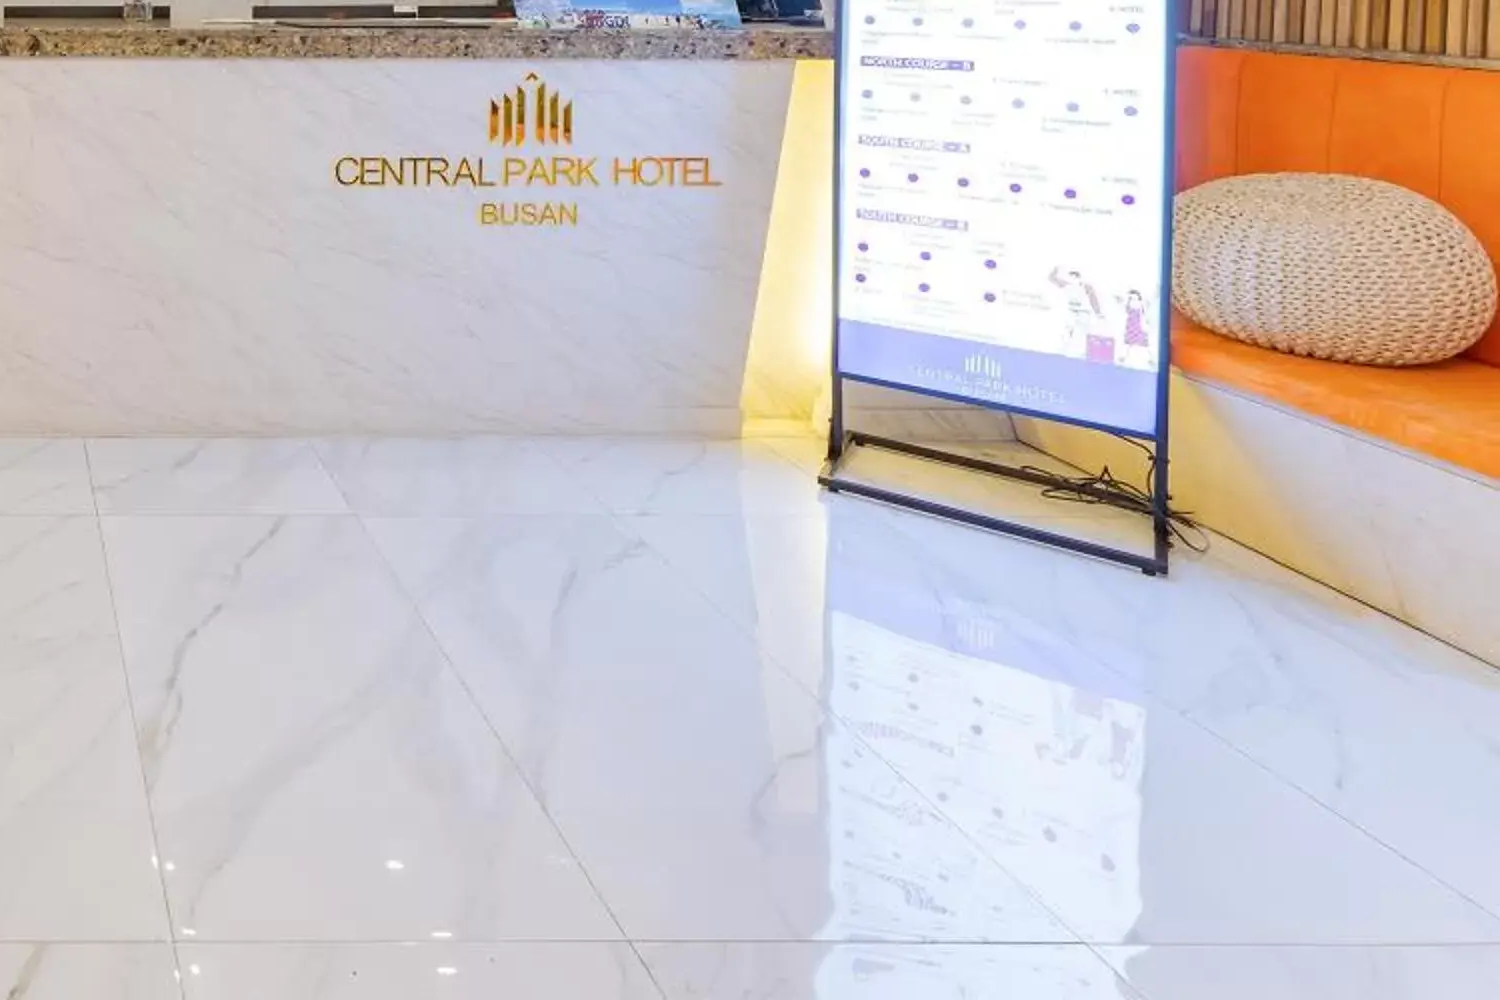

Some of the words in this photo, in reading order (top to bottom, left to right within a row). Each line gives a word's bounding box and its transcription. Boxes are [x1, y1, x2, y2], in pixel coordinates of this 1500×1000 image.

[335, 157, 497, 187] CENTRAL
[502, 157, 599, 187] PARK
[613, 157, 722, 187] HOTEL
[480, 202, 578, 227] BUSAN
